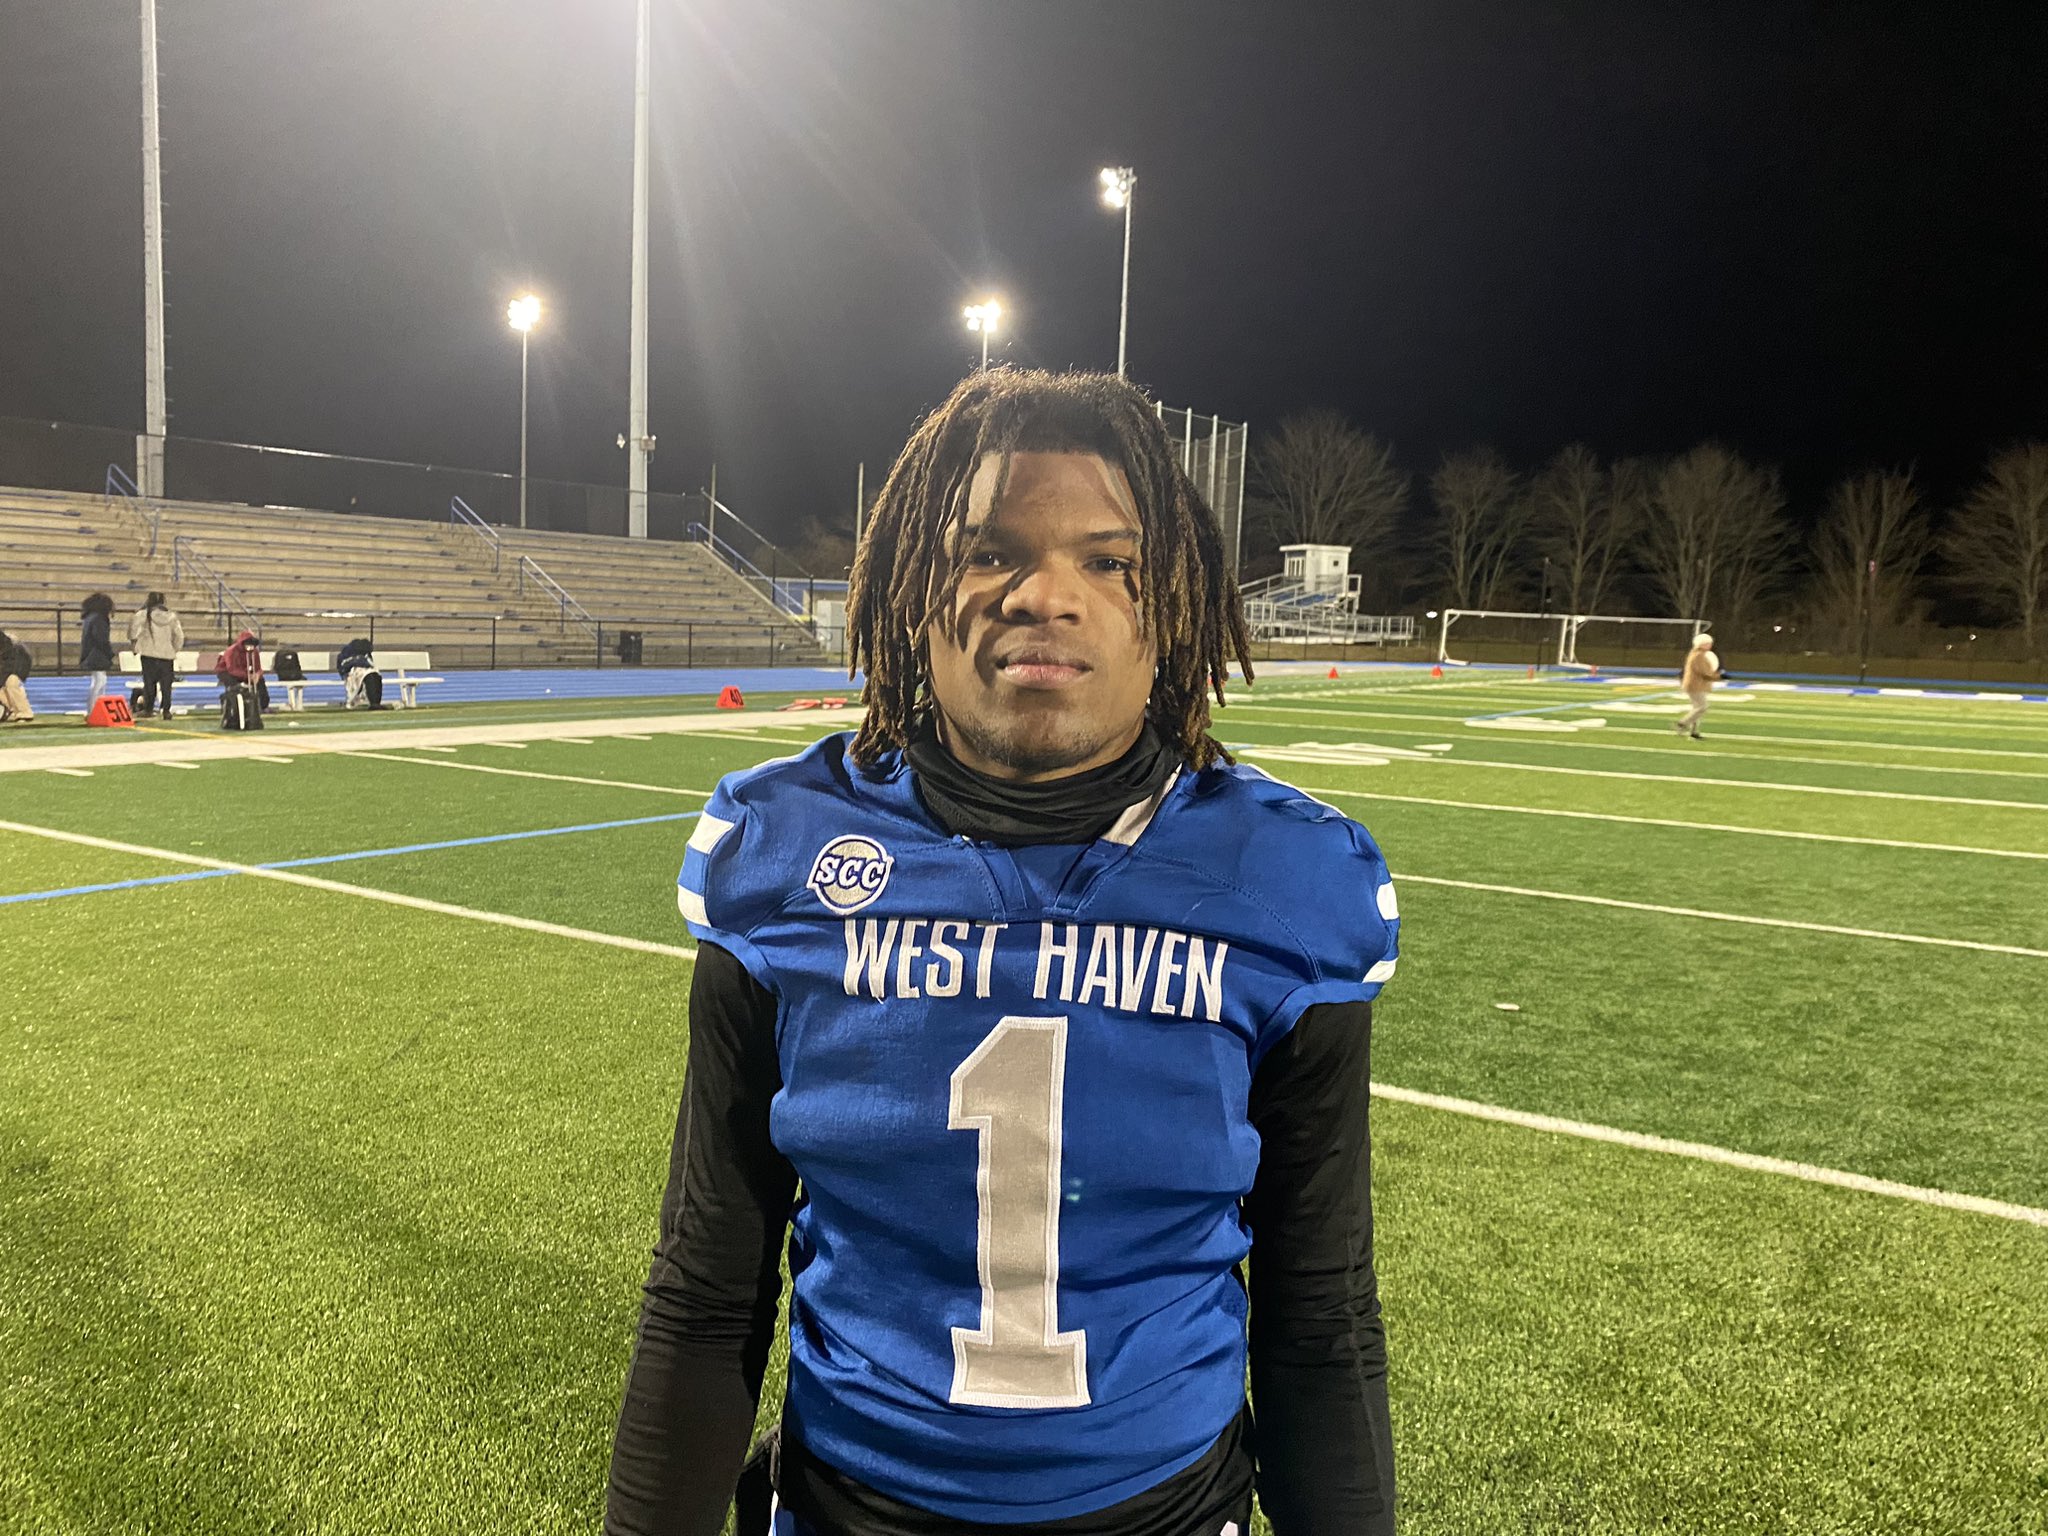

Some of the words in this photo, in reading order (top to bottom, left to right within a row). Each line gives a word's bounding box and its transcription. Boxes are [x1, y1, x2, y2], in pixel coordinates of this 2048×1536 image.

[104, 699, 131, 722] 50
[729, 688, 744, 706] 40
[813, 855, 886, 891] SCC
[843, 917, 1009, 1000] WEST
[1032, 920, 1229, 1023] HAVEN
[947, 1016, 1091, 1408] 1
